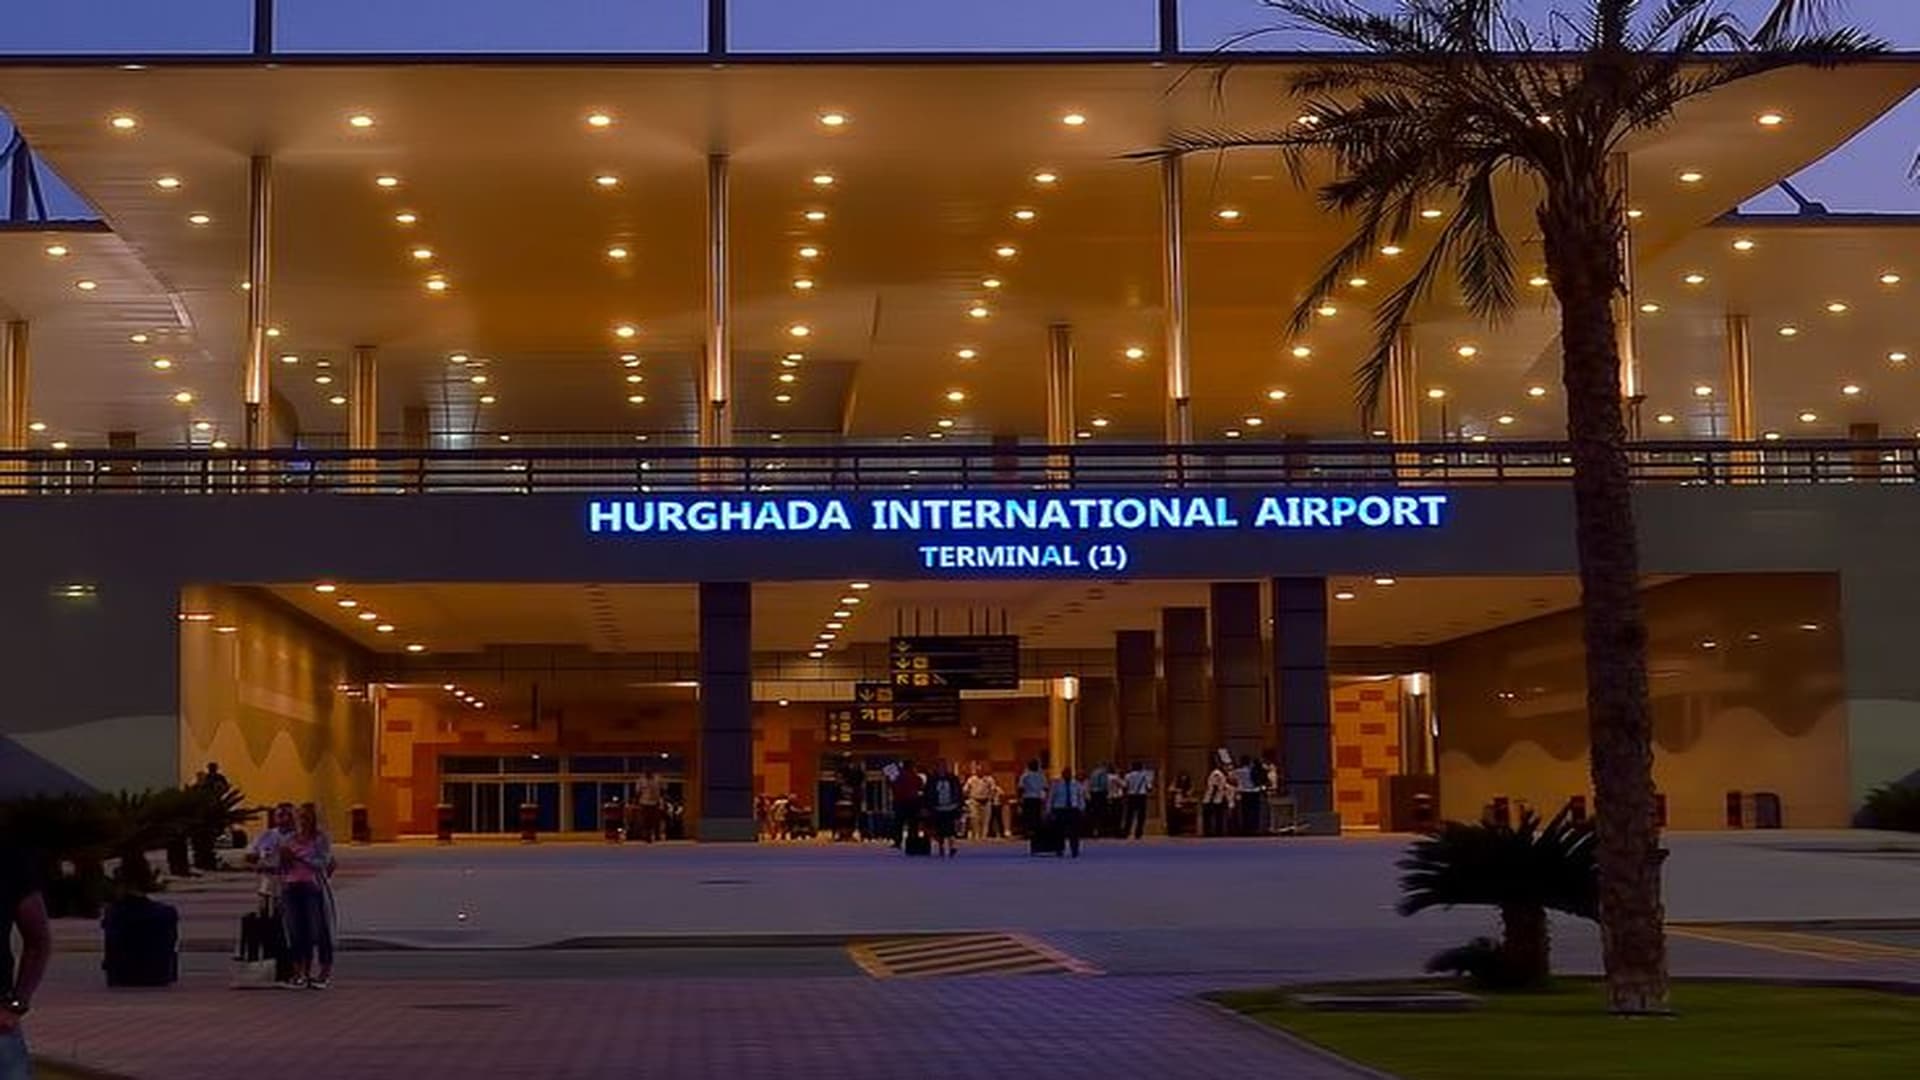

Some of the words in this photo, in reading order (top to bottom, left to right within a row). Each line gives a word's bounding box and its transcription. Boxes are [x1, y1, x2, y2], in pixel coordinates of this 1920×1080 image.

[589, 499, 850, 532] HURGHADA
[871, 497, 1238, 530] INTERNATIONAL
[1255, 495, 1447, 528] AIRPORT
[919, 545, 1080, 567] TERMINAL
[1088, 545, 1127, 571] (1)
